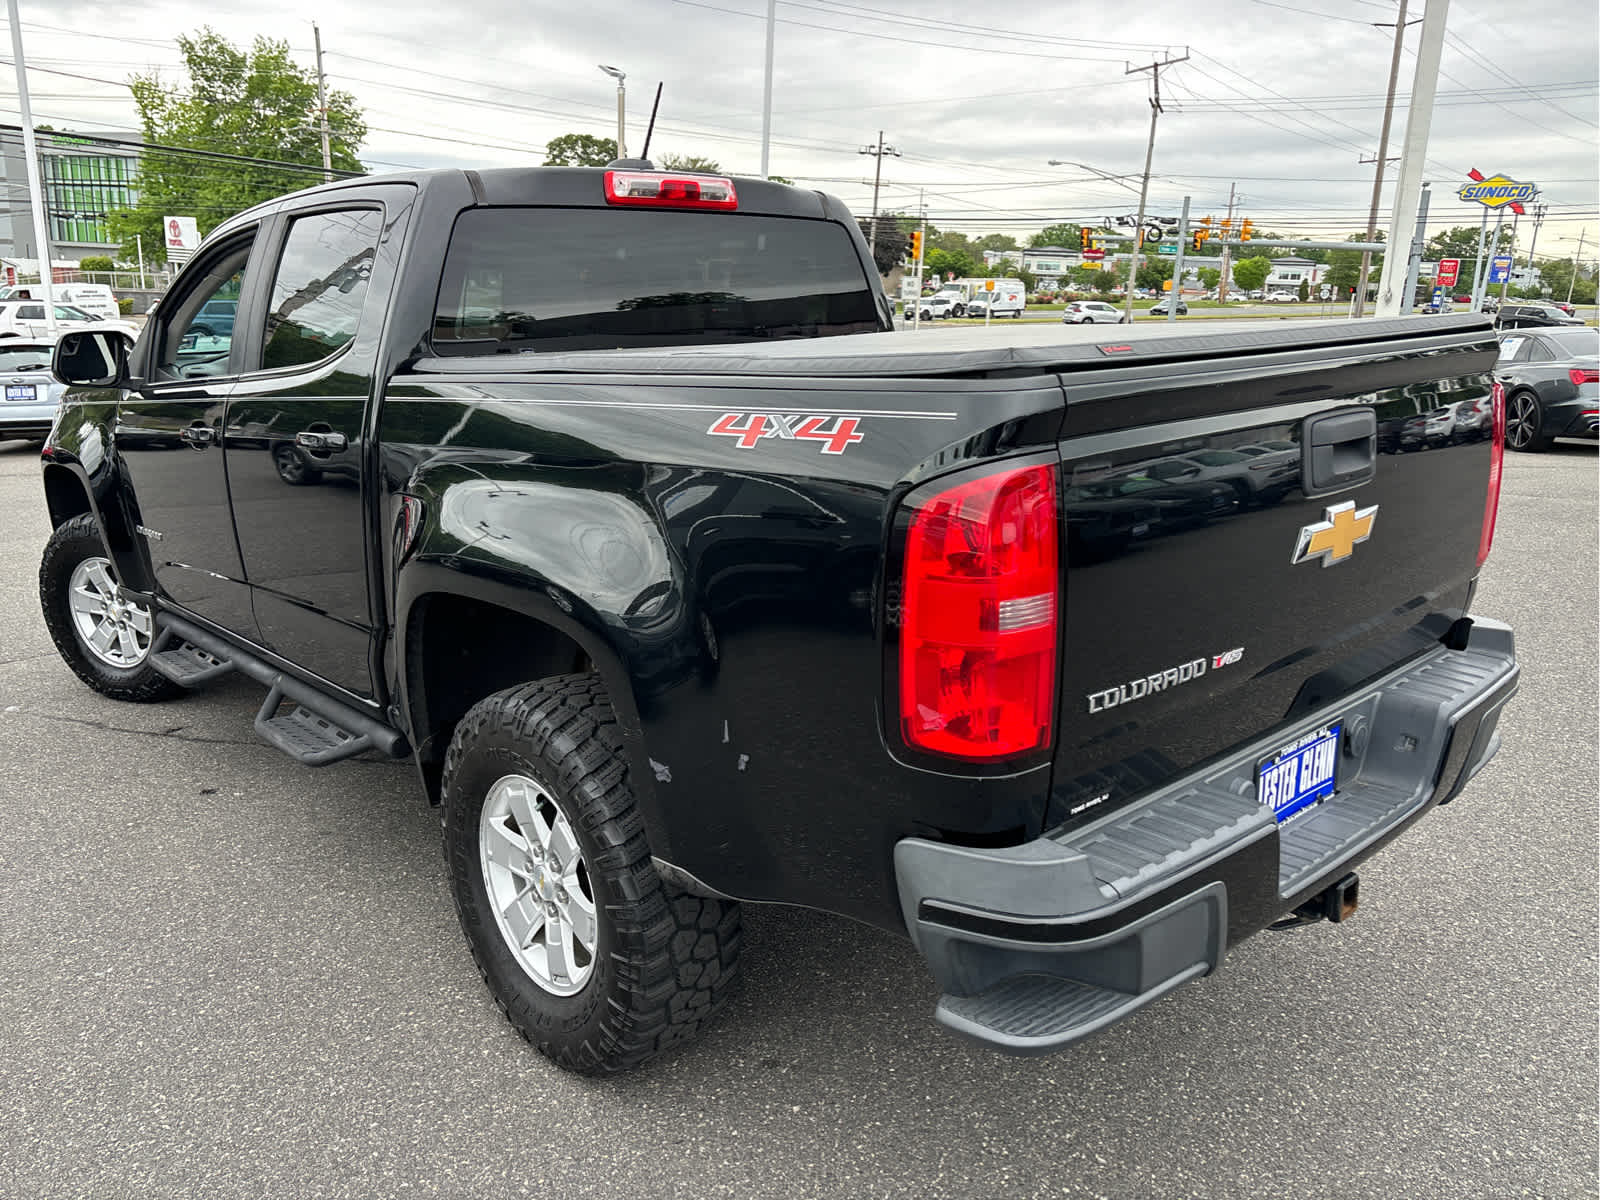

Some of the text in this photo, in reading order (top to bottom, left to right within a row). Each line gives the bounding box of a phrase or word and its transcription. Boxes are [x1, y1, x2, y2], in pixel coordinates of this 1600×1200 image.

[1463, 186, 1531, 198] SUNOCO
[1087, 657, 1208, 714] COLORADO
[1299, 736, 1337, 794] GLENN
